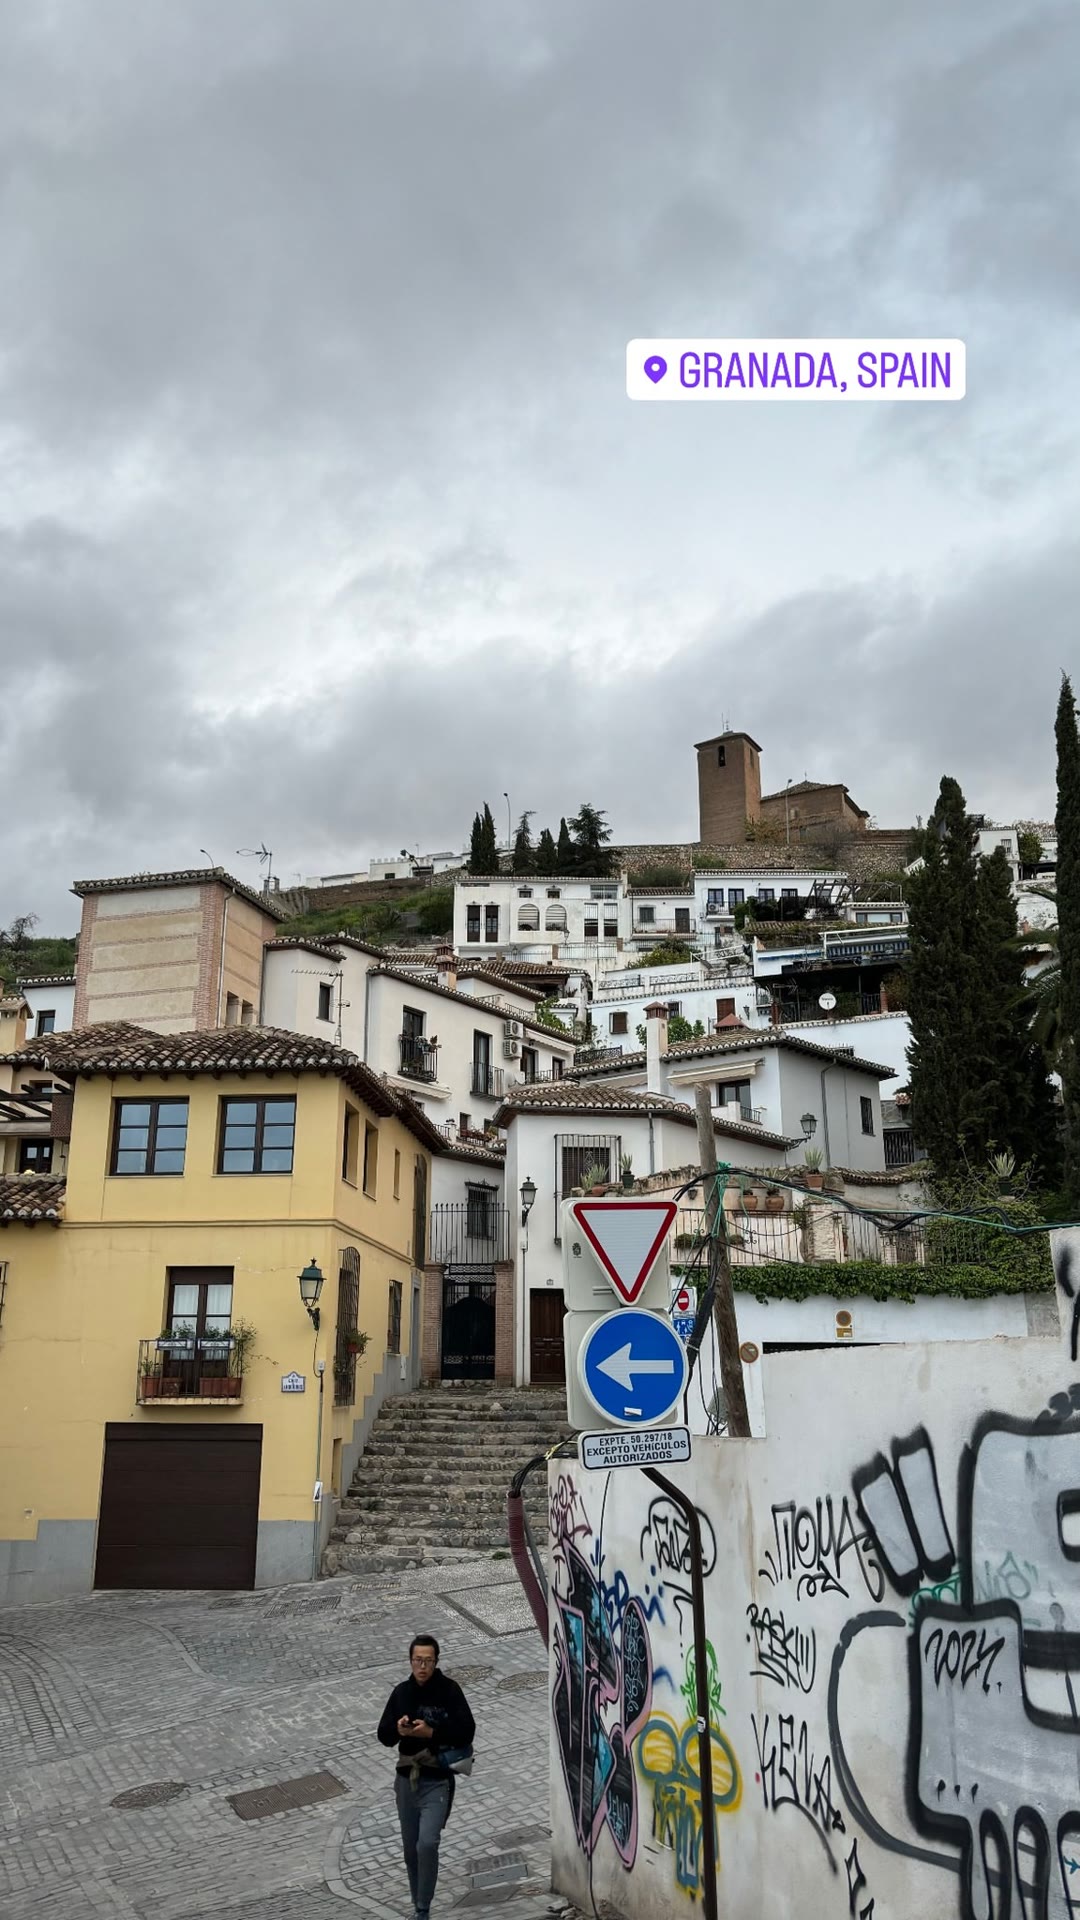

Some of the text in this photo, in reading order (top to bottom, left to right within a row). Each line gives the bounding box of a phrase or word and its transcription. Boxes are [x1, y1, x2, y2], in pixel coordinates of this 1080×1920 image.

[599, 1432, 673, 1446] EXPTE. 50.297/18
[586, 1440, 687, 1457] EXCEPTO VEHÍCULOS
[603, 1450, 672, 1465] AUTORIZADOS
